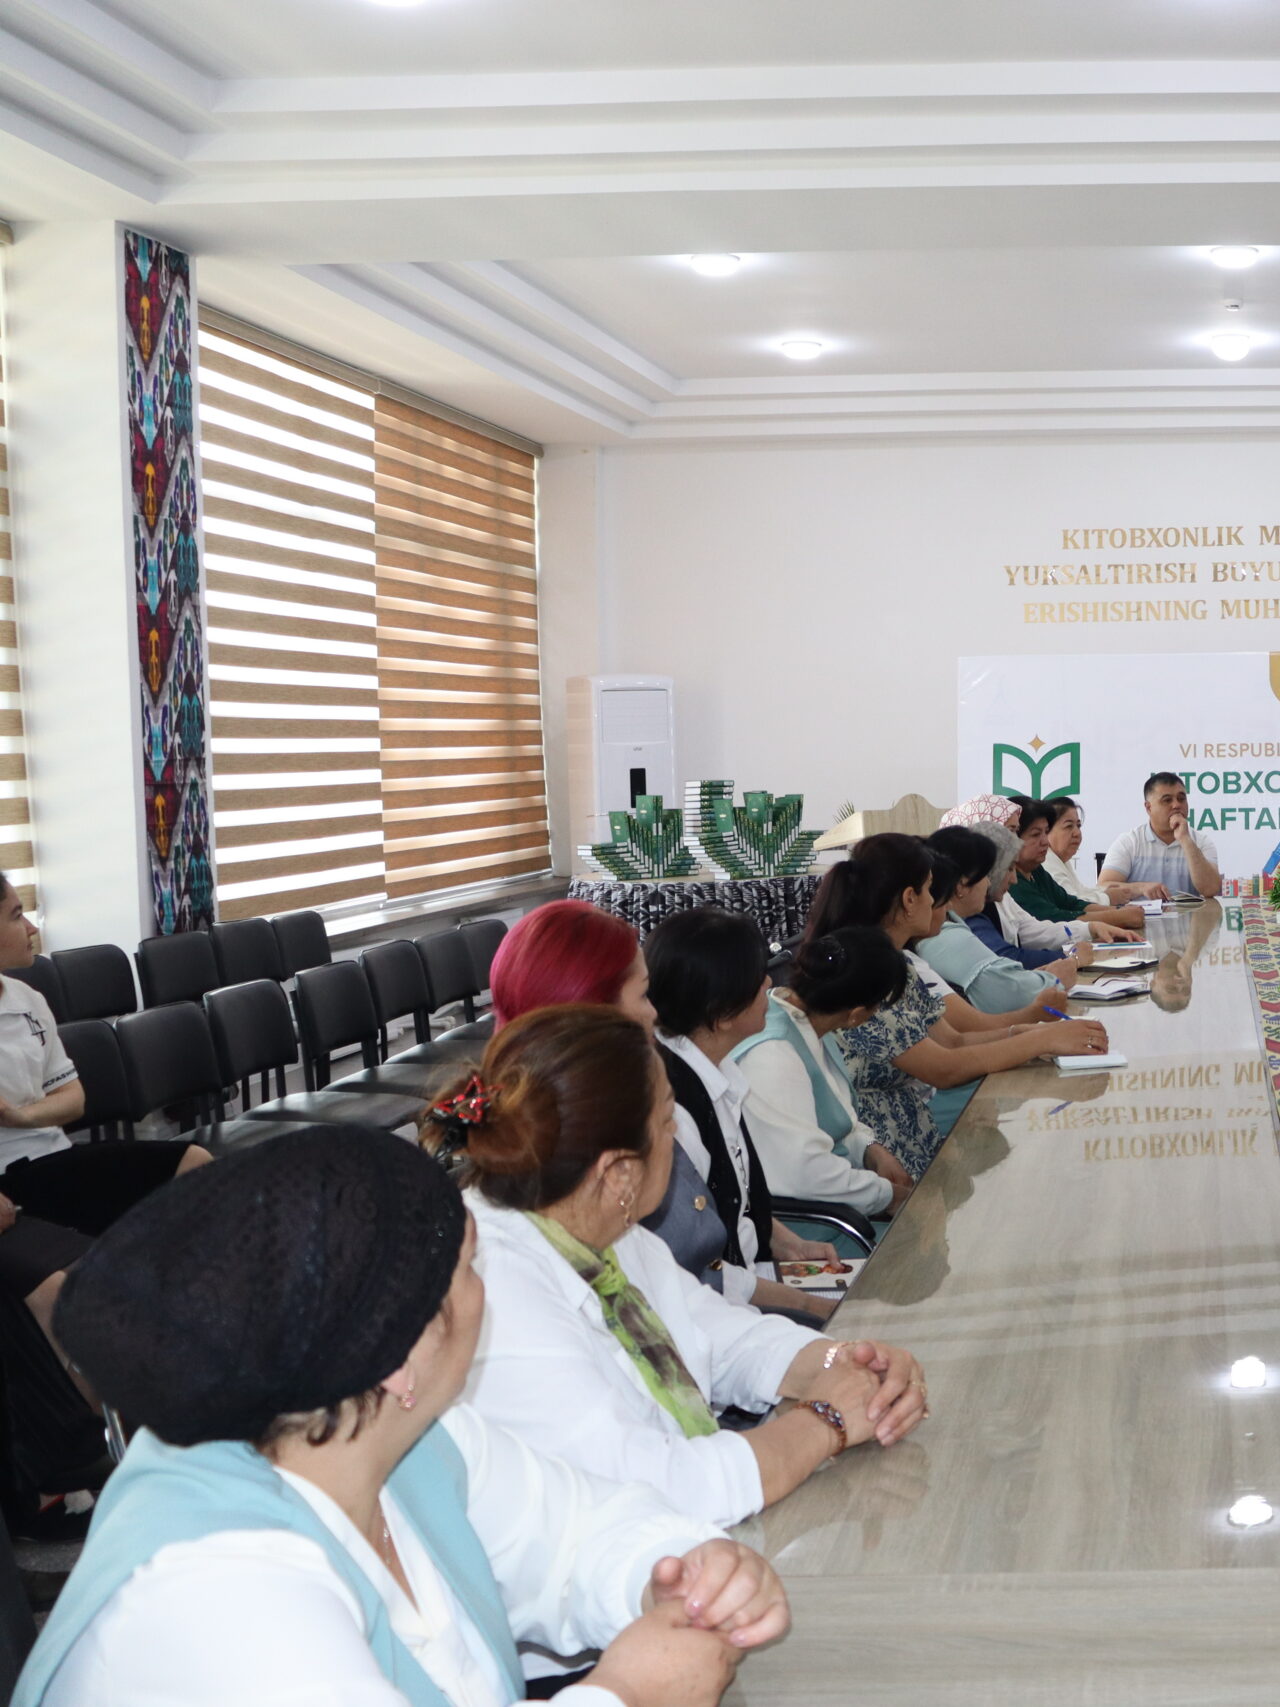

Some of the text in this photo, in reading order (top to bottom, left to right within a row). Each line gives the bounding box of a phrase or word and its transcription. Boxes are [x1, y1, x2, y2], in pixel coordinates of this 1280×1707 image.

[1061, 525, 1245, 550] KITOBXONLIK
[1003, 562, 1197, 586] YUKSALTIRISH
[1023, 599, 1208, 624] ERISHISHNING
[1179, 743, 1197, 758] VI
